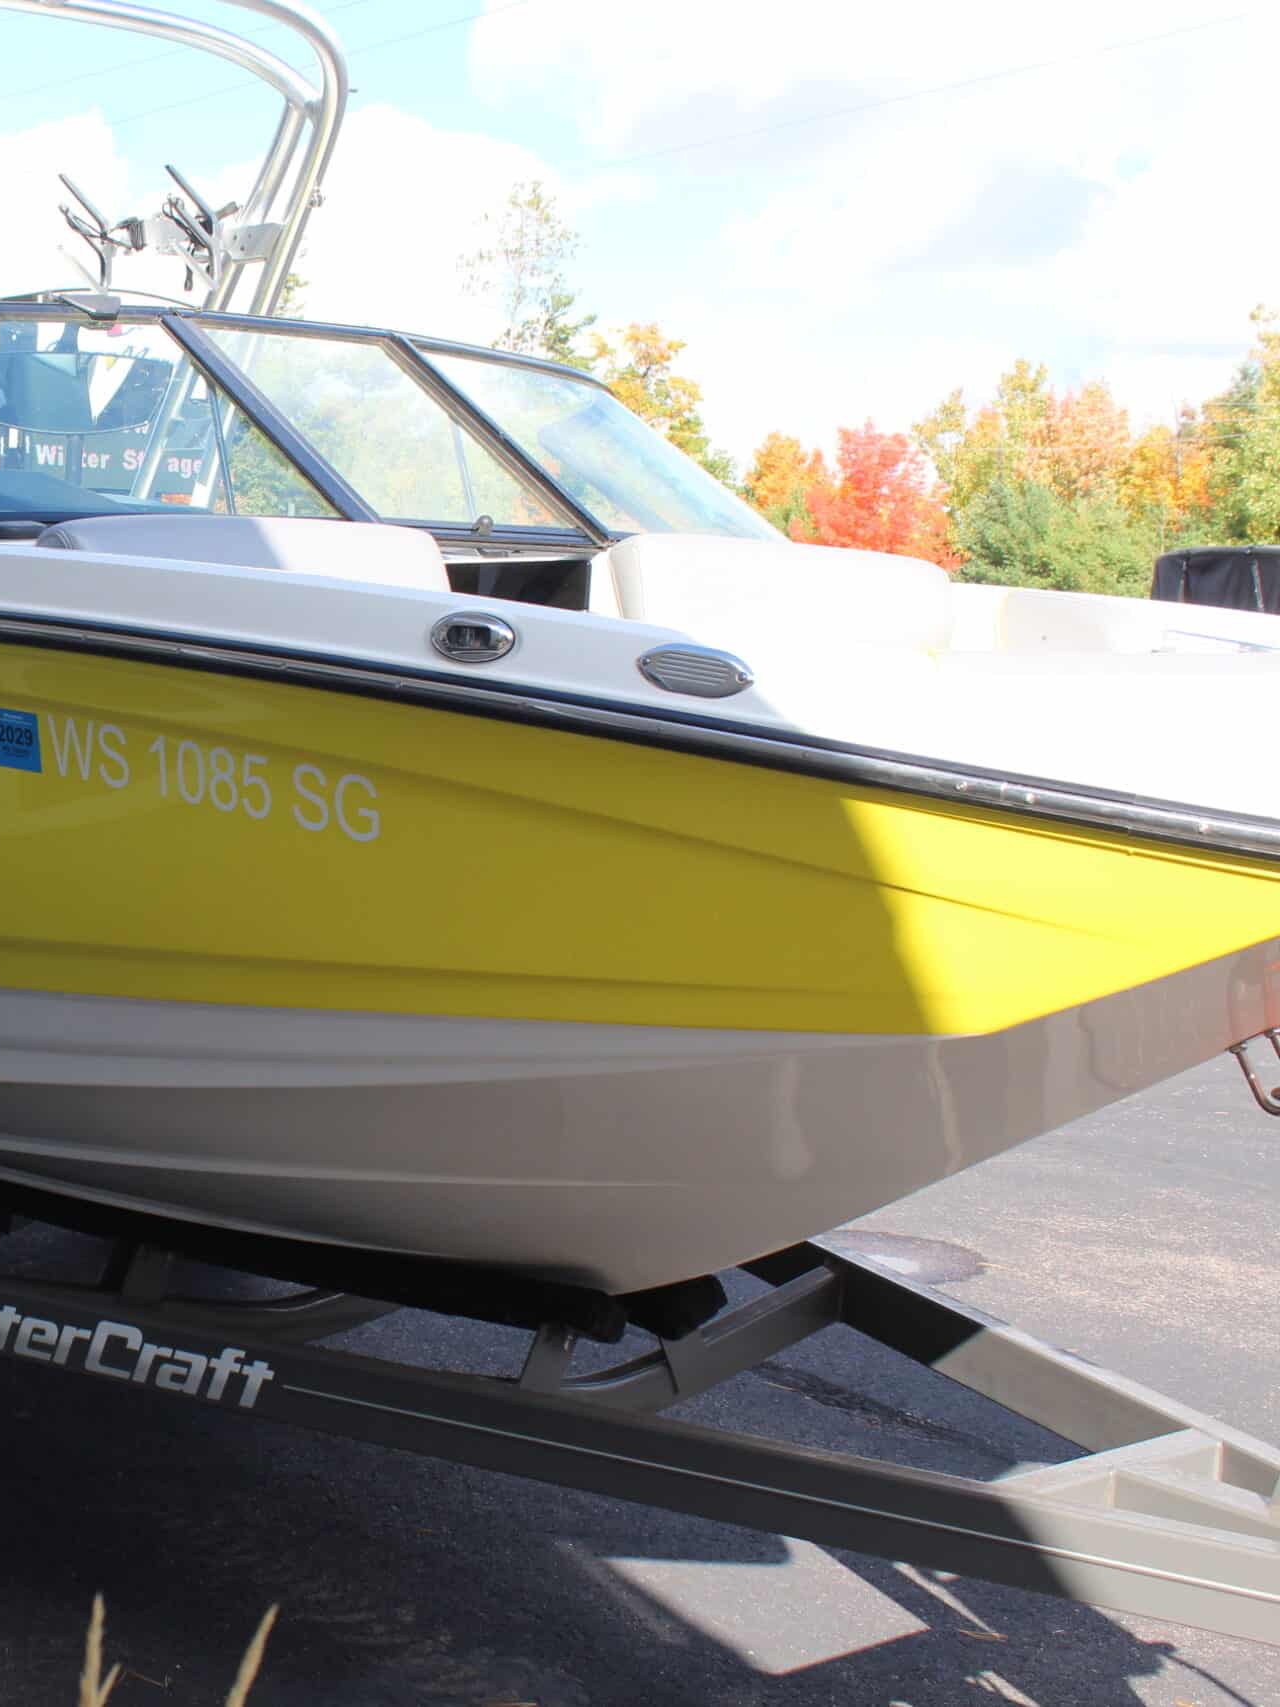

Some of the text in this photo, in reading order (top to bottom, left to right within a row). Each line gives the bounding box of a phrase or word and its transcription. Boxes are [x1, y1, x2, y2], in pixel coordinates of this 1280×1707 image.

[36, 442, 203, 478] Witer Stage
[47, 714, 381, 842] WS 1085 SG
